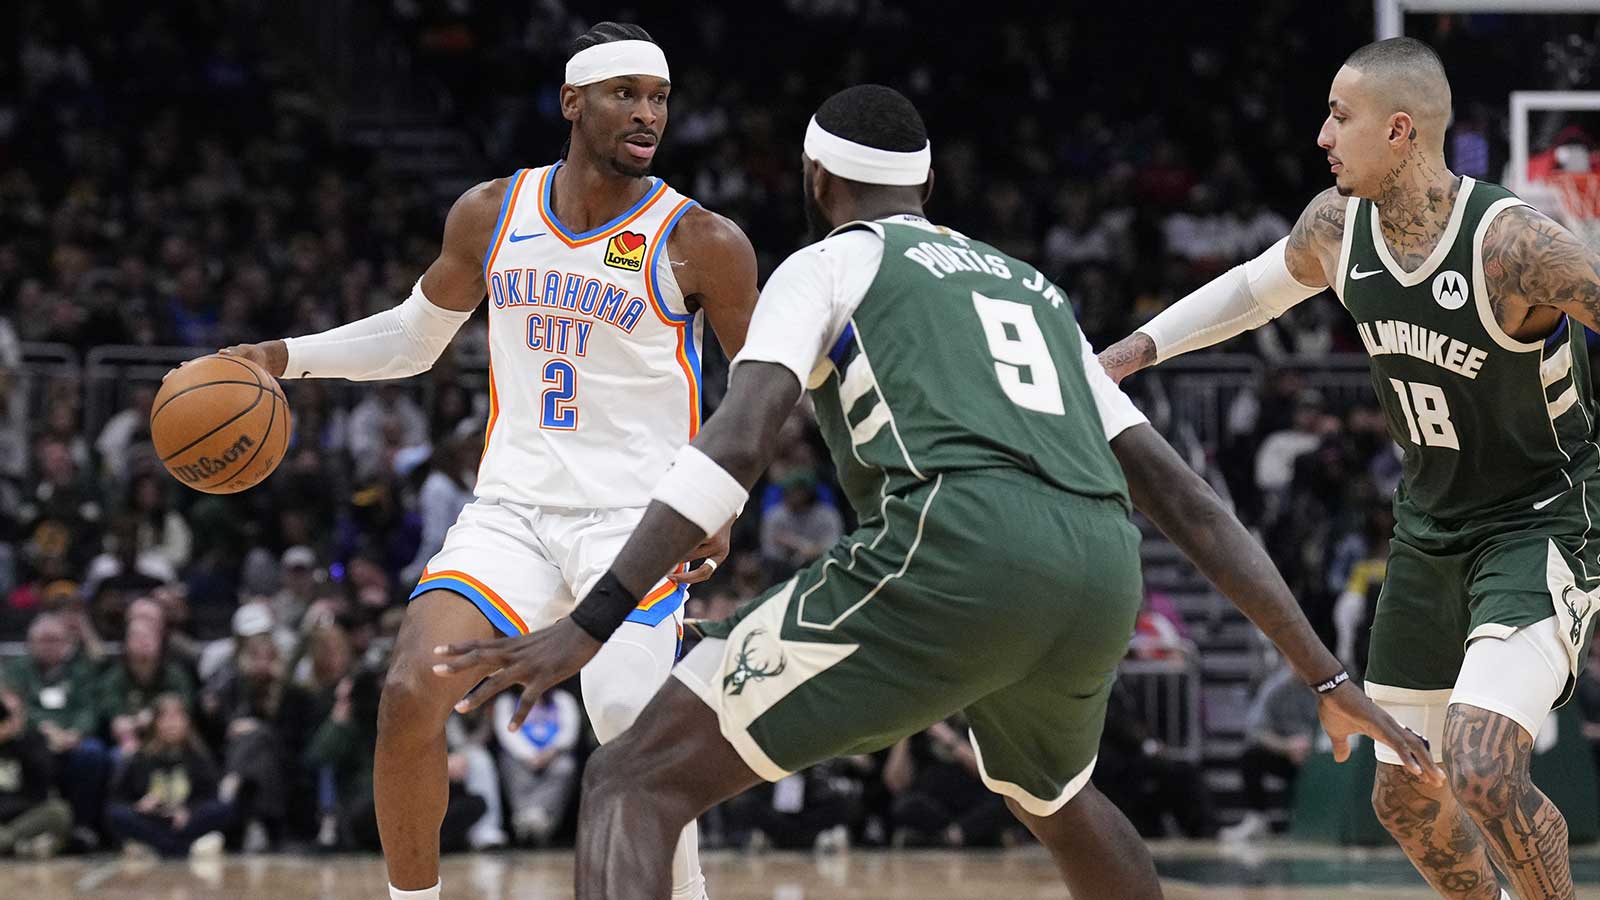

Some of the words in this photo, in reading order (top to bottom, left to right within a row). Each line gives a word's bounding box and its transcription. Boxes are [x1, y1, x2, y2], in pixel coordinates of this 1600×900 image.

[903, 241, 1012, 279] PORTIS
[490, 268, 647, 334] OKLAHOMA
[526, 313, 593, 357] CITY
[971, 290, 1066, 415] 9
[1357, 319, 1489, 380] ILWAUKEE
[539, 358, 578, 431] 2
[1388, 377, 1460, 451] 18
[171, 434, 255, 483] Wilson
